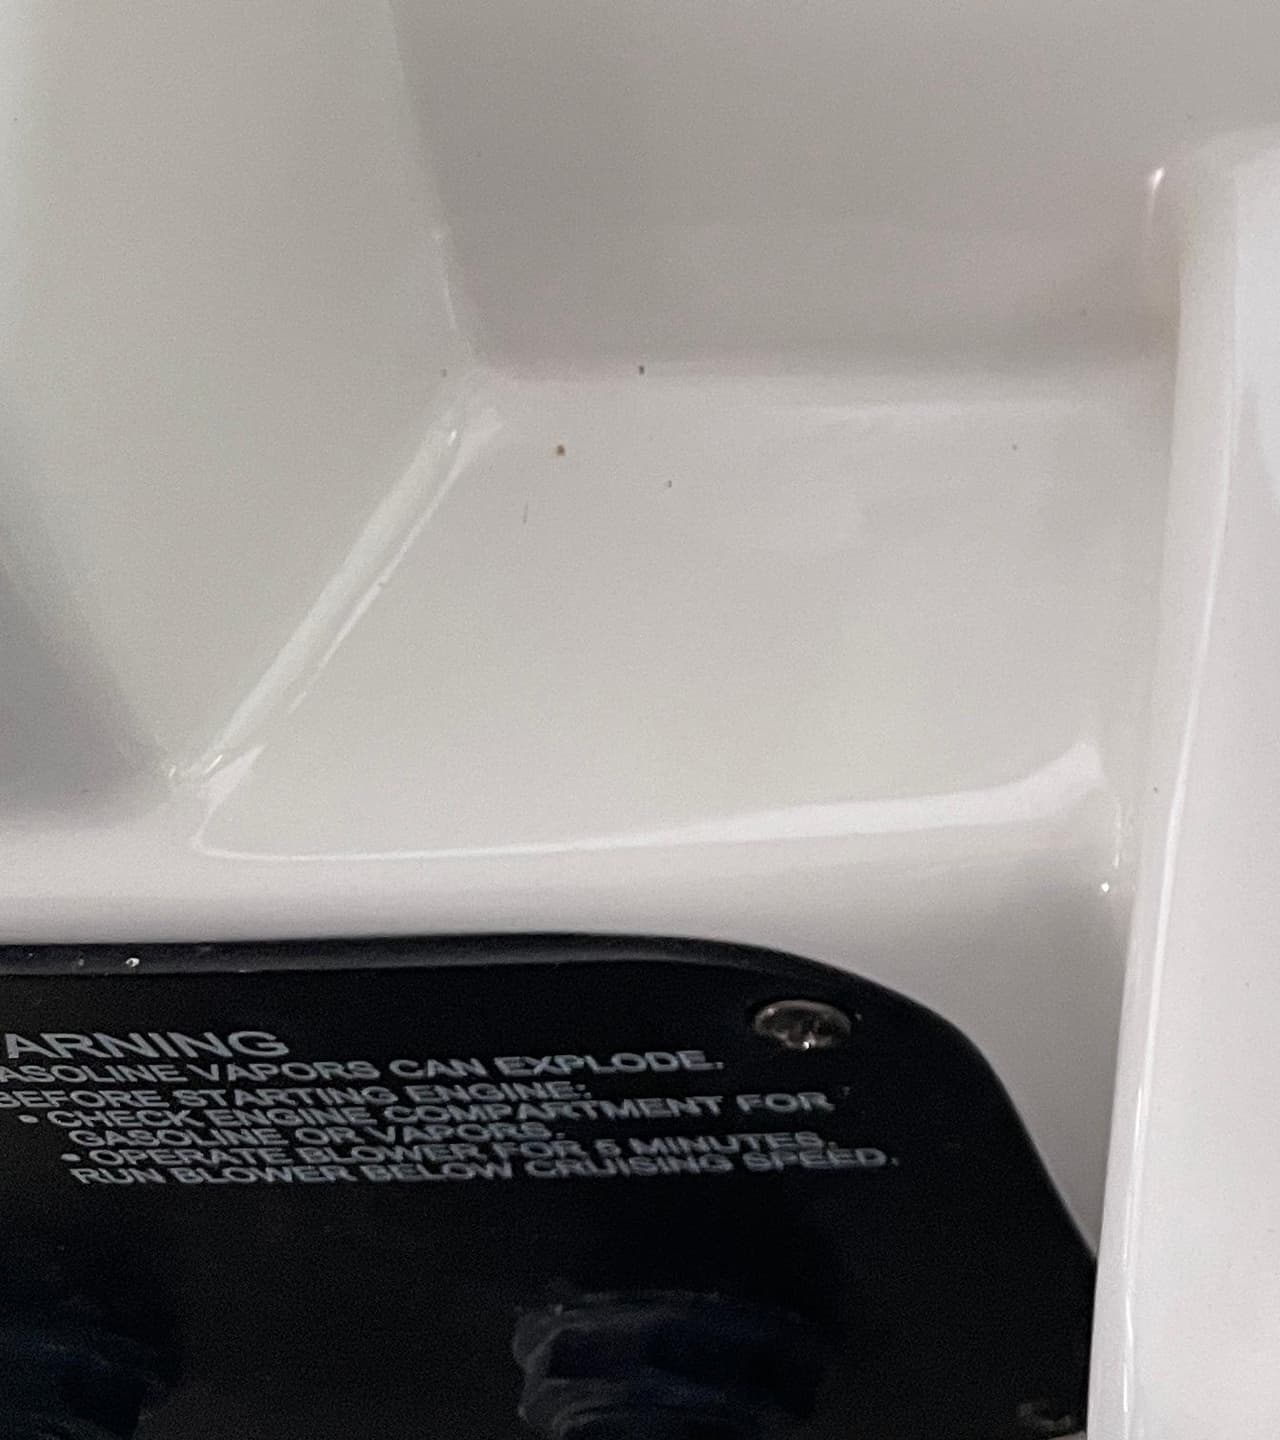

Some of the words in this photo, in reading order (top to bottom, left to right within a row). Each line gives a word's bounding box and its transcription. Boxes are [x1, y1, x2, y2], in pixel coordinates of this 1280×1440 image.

[5, 1031, 290, 1060] ARNING
[0, 1063, 189, 1084] ASOLINE
[186, 1060, 380, 1082] VAPORS
[389, 1057, 487, 1079] CAN
[494, 1049, 724, 1078] EXPLODE.
[47, 1107, 205, 1128] CHECK
[204, 1106, 377, 1127] ENGINE
[384, 1094, 724, 1124] COMPARTMENT
[736, 1091, 836, 1113] FOR
[172, 1086, 399, 1108] STARTING
[404, 1080, 592, 1104] ENGINE:
[68, 1127, 290, 1147] GASOLINE
[295, 1126, 364, 1145] OR
[364, 1121, 565, 1145] VAPORS.
[89, 1147, 293, 1166] OPERATE
[295, 1142, 487, 1163] BLOWER
[492, 1139, 588, 1159] FOR
[628, 1131, 837, 1156] MINUTES.
[69, 1167, 166, 1184] RUN
[175, 1164, 358, 1184] BLOWER
[360, 1161, 513, 1182] BELOW
[525, 1152, 733, 1179] CRUISING
[743, 1146, 898, 1172] SPEED.
